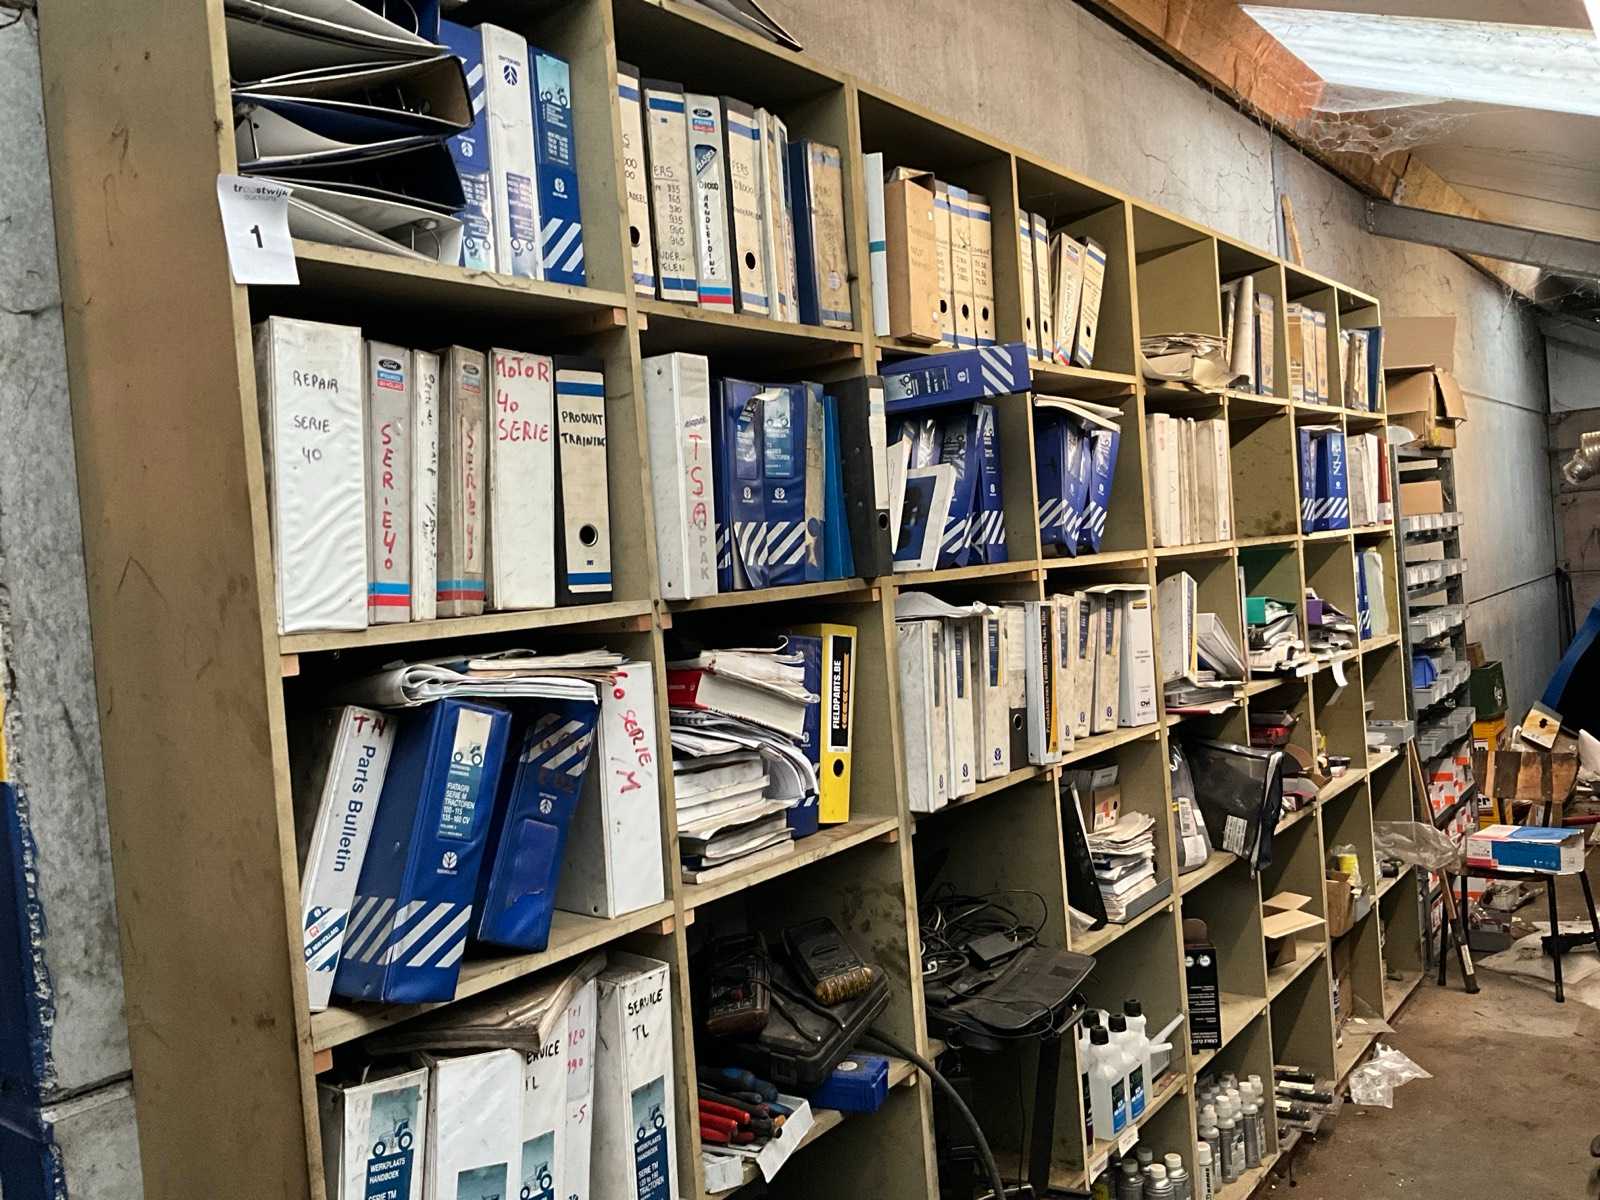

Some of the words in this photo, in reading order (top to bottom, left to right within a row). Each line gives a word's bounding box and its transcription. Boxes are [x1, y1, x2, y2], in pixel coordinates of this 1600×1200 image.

[250, 224, 263, 249] 1
[495, 356, 549, 382] MOTOR
[293, 370, 339, 393] REPAIR
[496, 389, 519, 413] 40
[294, 415, 331, 433] SERIE
[561, 410, 604, 426] PRODUKT
[498, 418, 549, 442] SERIE
[301, 446, 322, 465] 40
[832, 660, 842, 730] FIELDPARTS.BE
[352, 745, 377, 794] Parts
[444, 797, 475, 810] TRACTOREN
[333, 800, 363, 873] Bulletin
[632, 1024, 649, 1041] TL
[527, 1040, 560, 1065] ERVICE
[370, 1157, 406, 1173] WERKPLAATS
[369, 1169, 400, 1185] HANDBOEK
